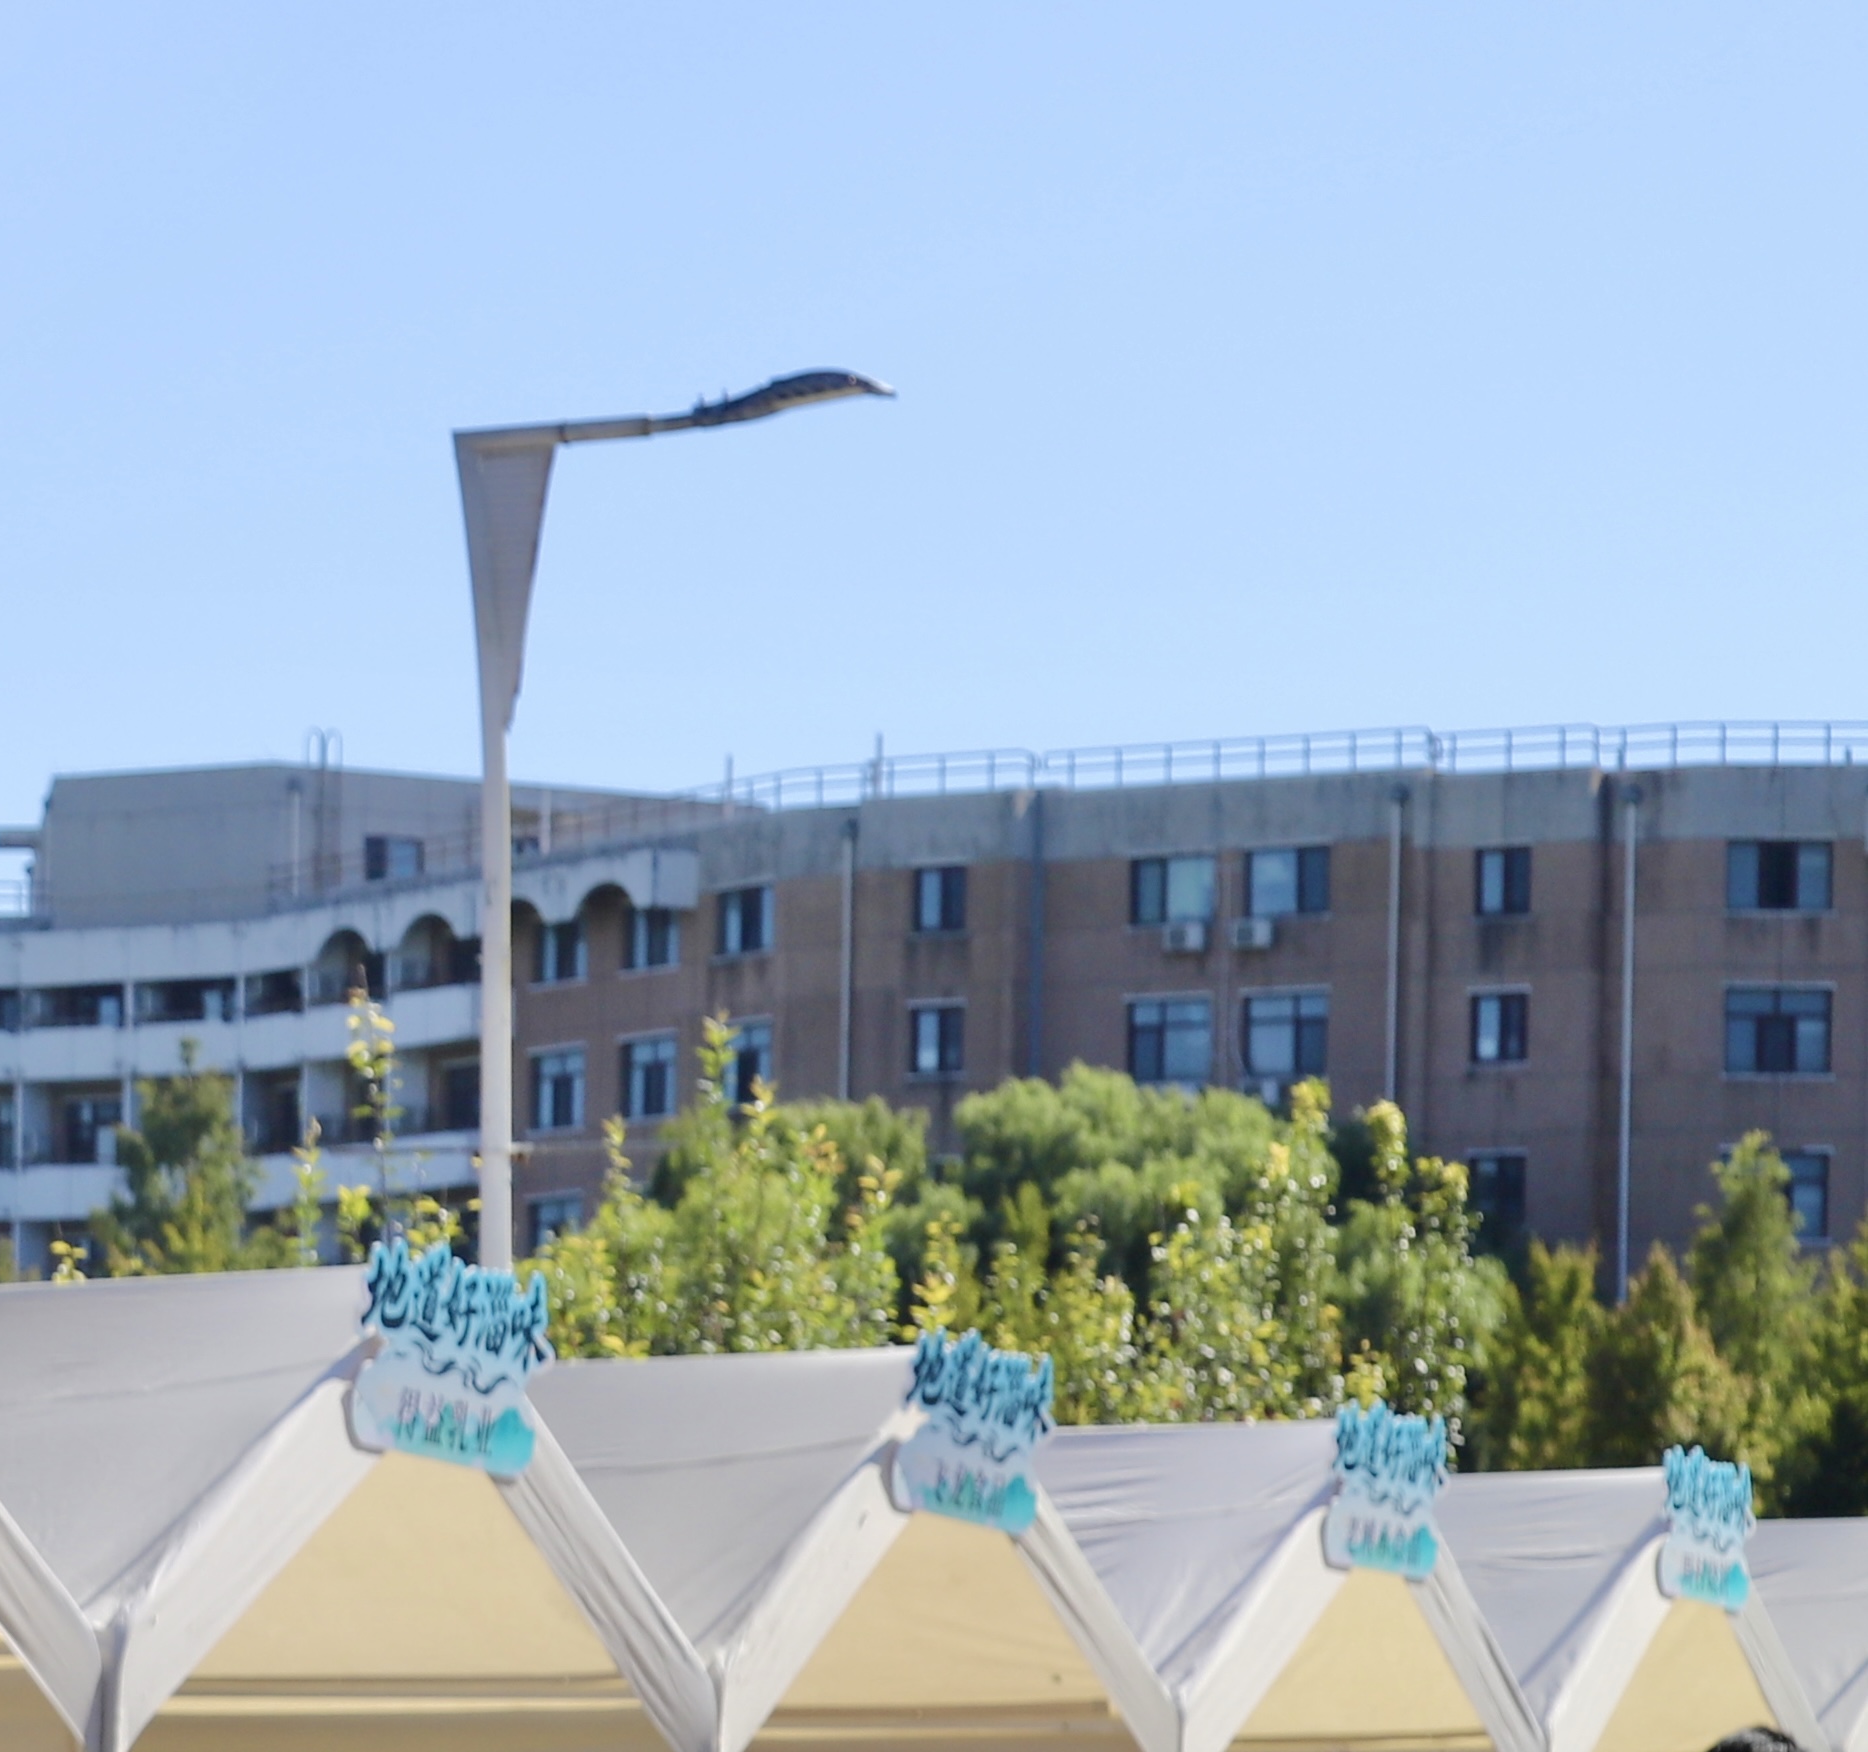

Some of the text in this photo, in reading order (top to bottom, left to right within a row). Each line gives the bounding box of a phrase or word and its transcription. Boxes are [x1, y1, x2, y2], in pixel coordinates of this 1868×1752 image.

[360, 1249, 545, 1372] 地道好淄味
